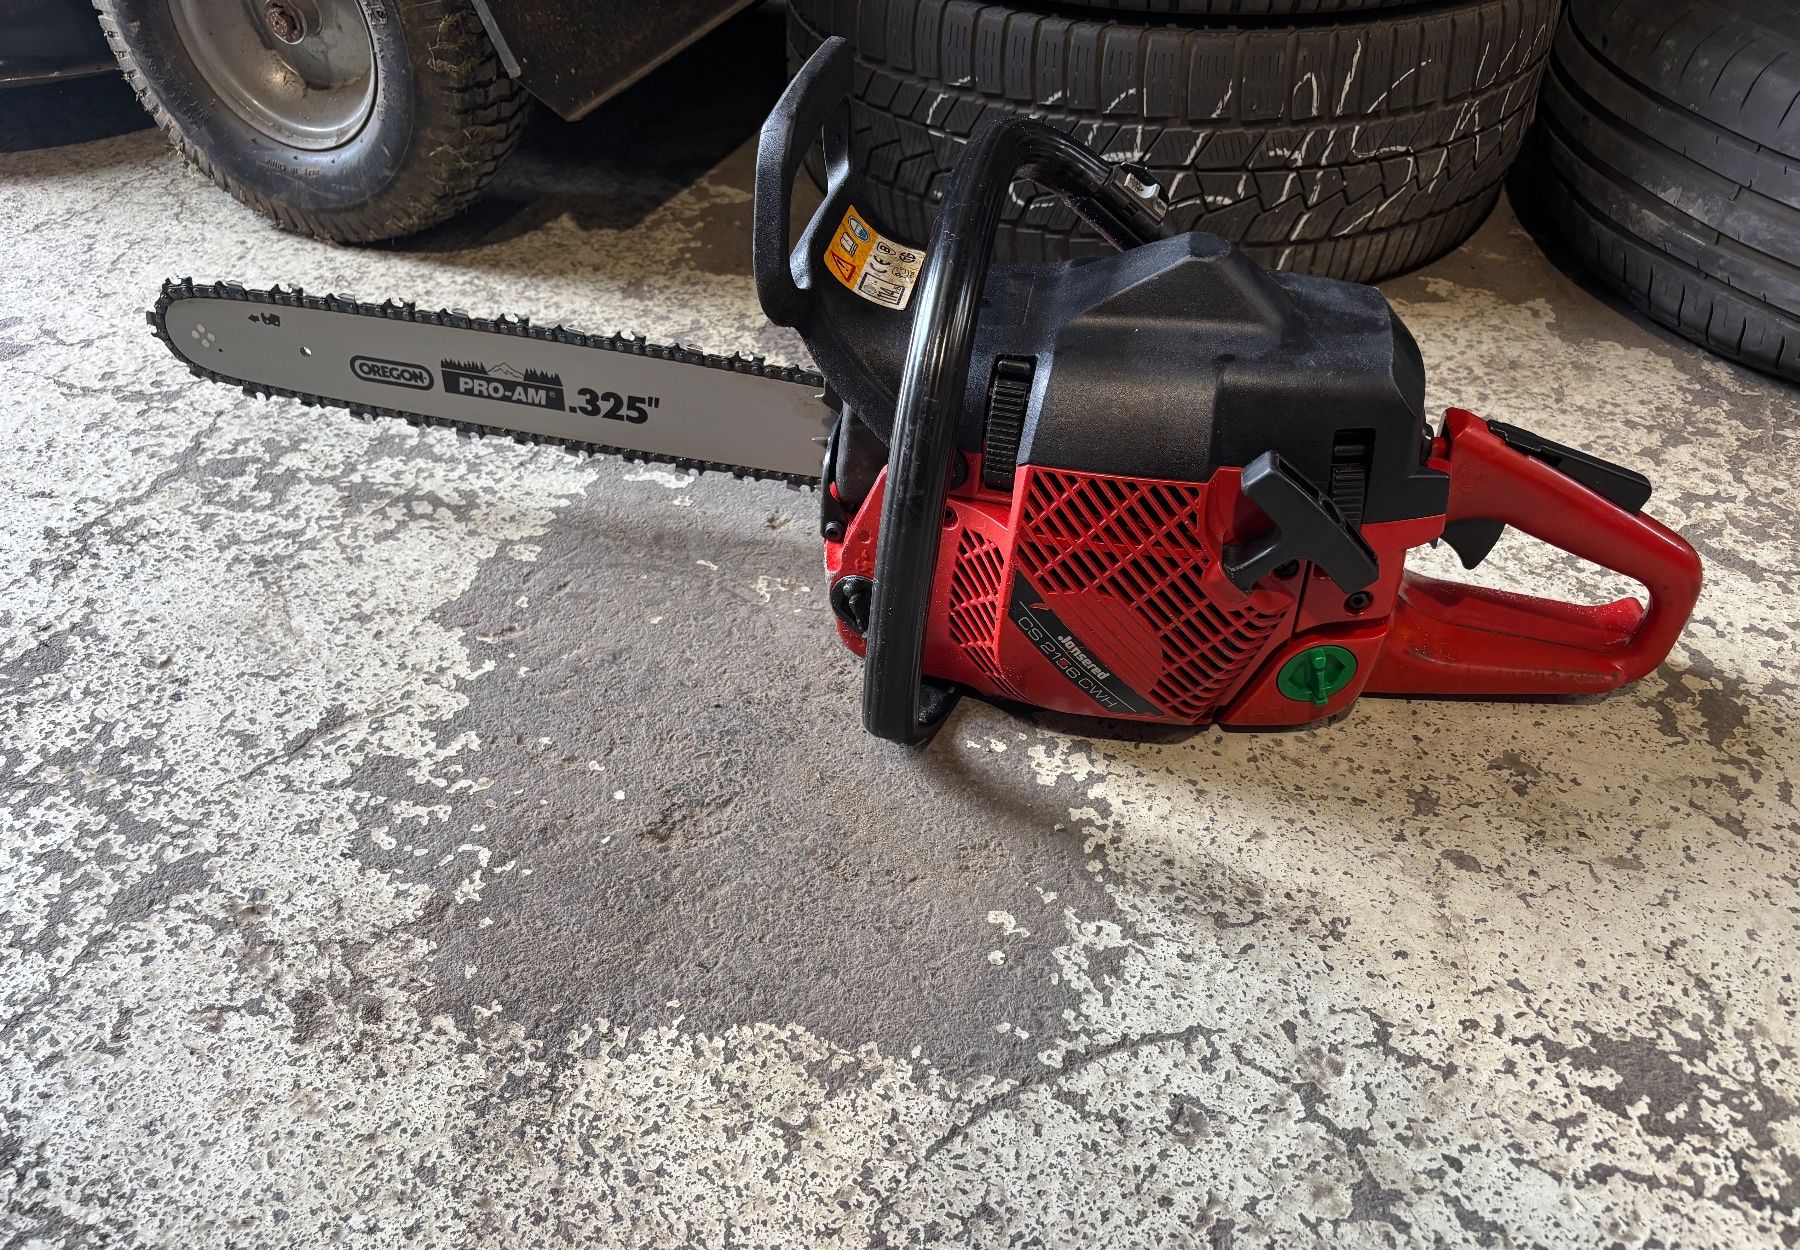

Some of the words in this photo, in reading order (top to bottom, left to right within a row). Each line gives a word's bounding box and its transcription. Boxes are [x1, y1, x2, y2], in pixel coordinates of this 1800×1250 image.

[358, 360, 424, 385] OREGON
[459, 376, 546, 406] PRO-AM
[568, 387, 660, 425] .325"
[1018, 617, 1043, 642] CS
[1079, 678, 1117, 708] CWH
[1058, 636, 1110, 680] Jonsered
